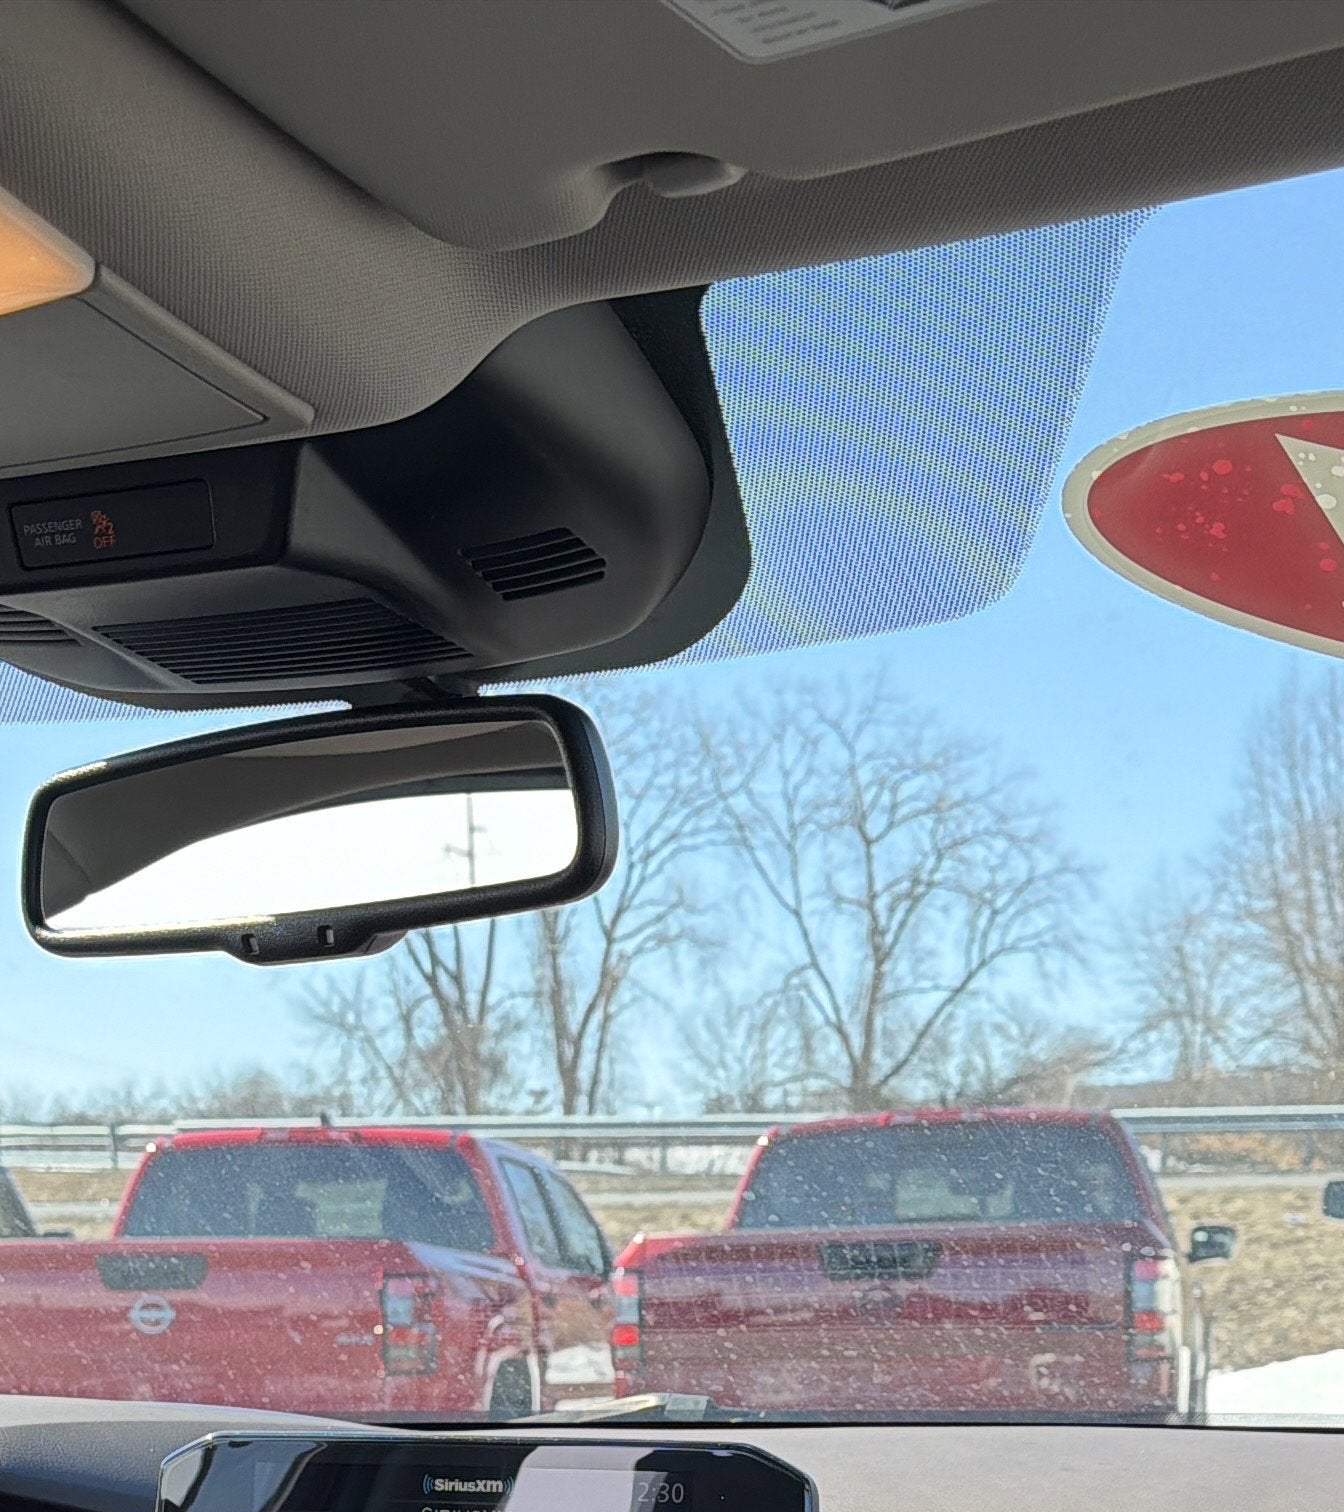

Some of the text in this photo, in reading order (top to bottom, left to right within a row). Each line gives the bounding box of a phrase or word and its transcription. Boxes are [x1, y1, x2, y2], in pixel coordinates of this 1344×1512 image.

[23, 519, 82, 535] PASSENGER
[35, 533, 76, 547] AIR BAG
[94, 536, 116, 549] OFF
